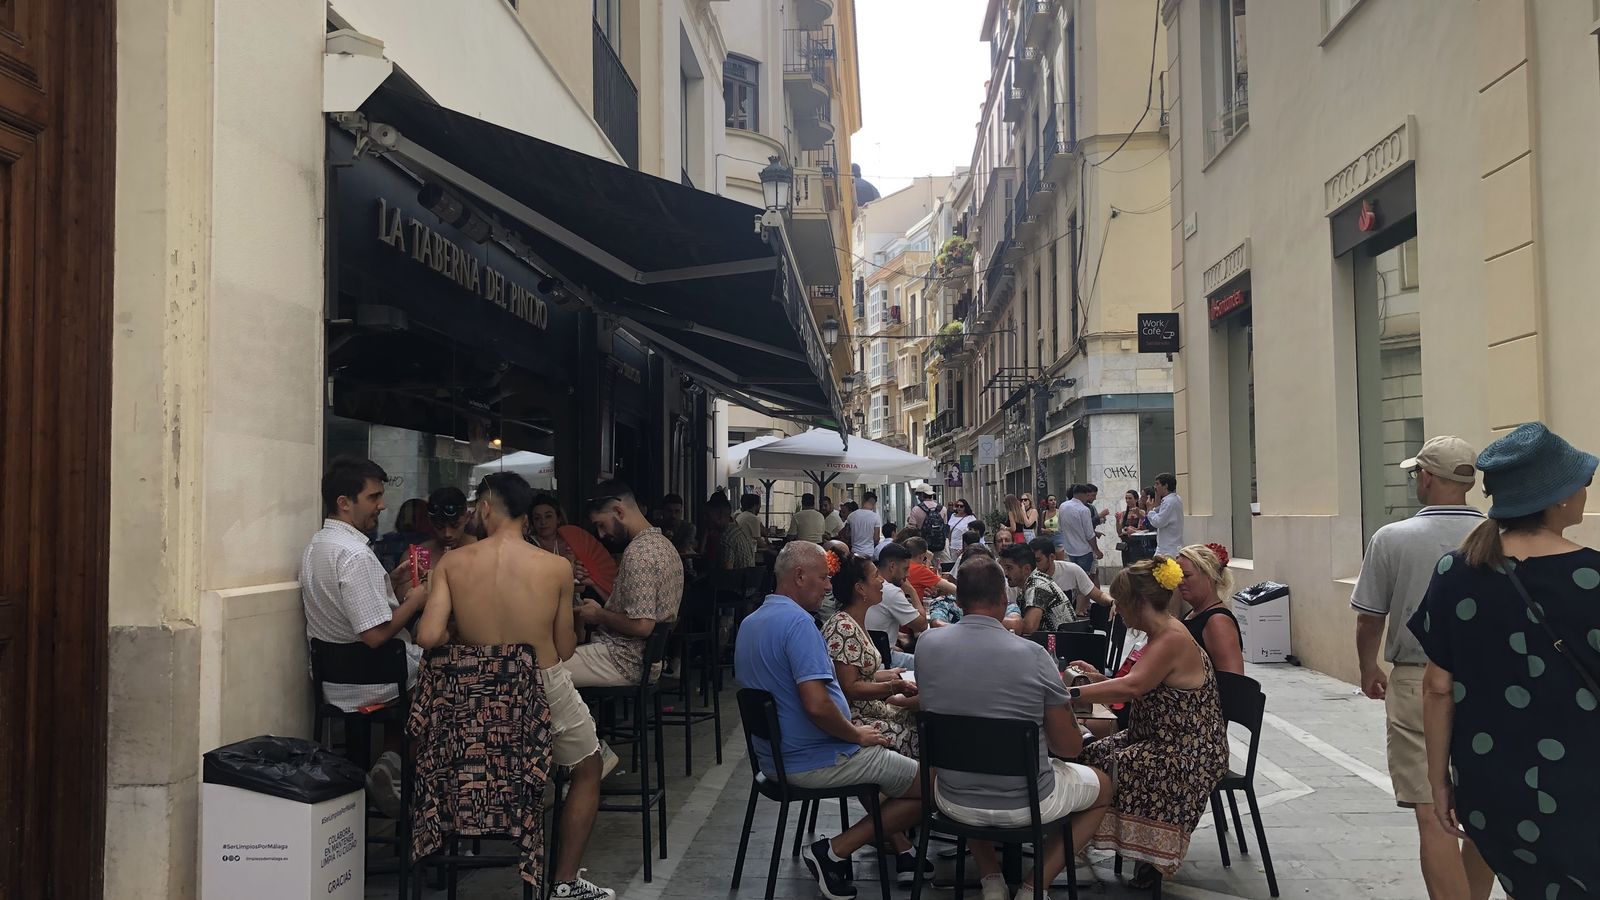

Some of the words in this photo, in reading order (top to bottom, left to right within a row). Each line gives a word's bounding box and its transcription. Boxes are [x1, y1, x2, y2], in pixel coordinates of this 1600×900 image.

[376, 197, 406, 253] LA
[408, 216, 482, 295] TABERNA
[483, 264, 509, 309] DEL
[509, 280, 548, 331] PINTXO
[1142, 319, 1165, 328] Work
[324, 847, 331, 857] EN
[331, 832, 354, 852] MANTENER
[328, 826, 351, 846] COLABORA
[320, 853, 336, 868] LIMPIA
[342, 839, 358, 855] CIUDAD
[327, 869, 352, 894] GRACIAS
